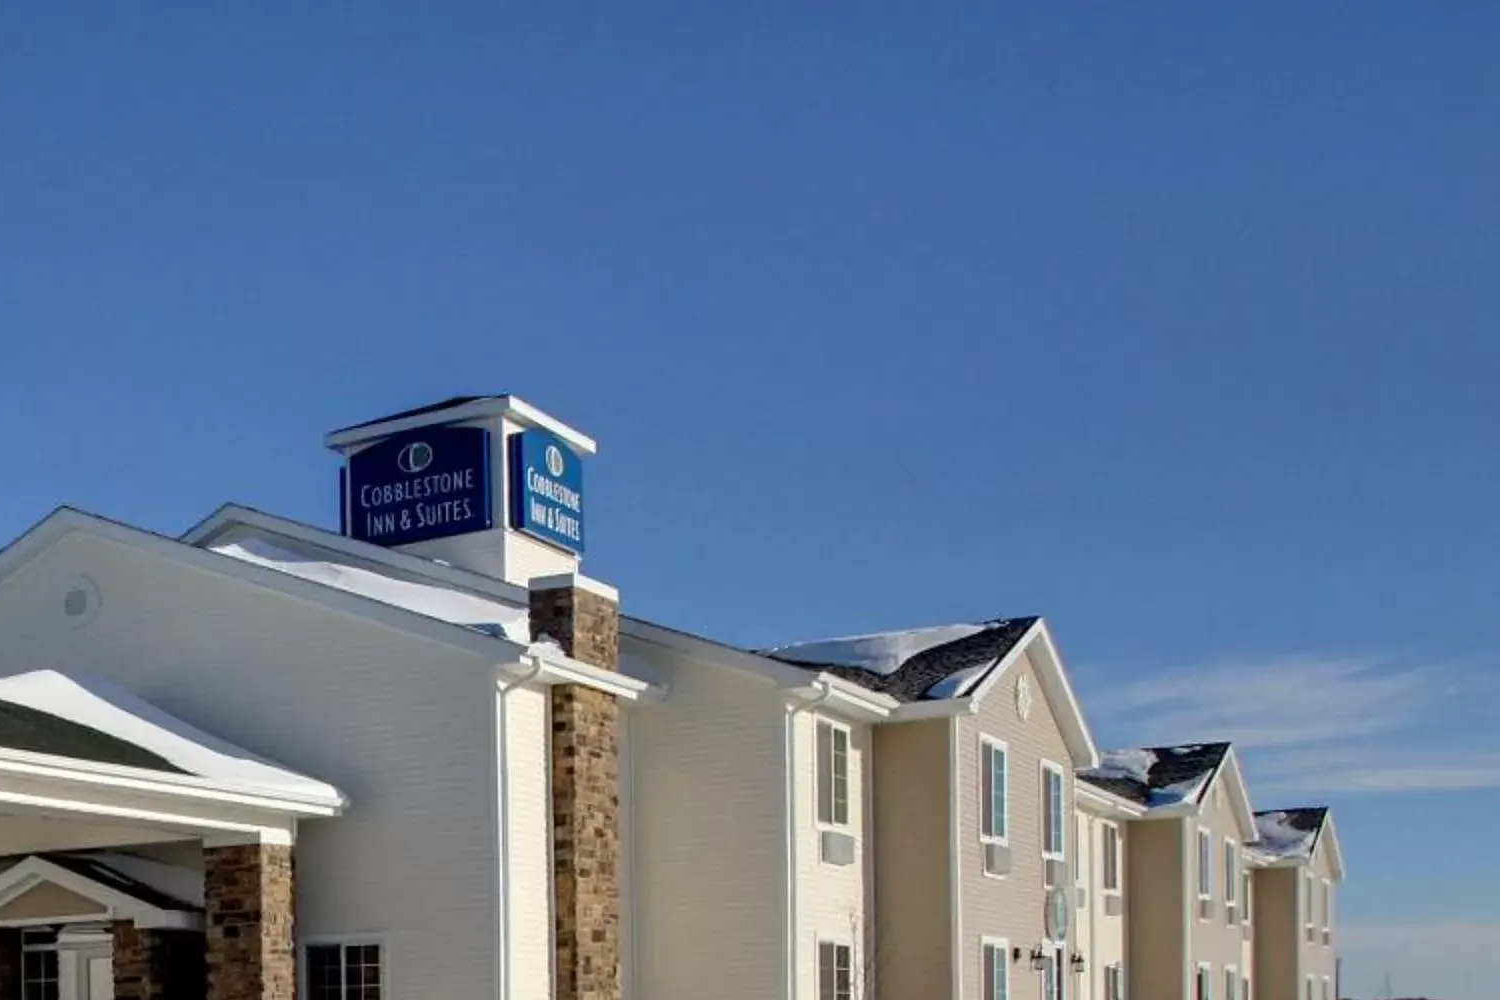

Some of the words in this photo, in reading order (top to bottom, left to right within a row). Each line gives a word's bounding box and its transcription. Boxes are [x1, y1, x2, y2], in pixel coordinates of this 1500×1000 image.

[361, 468, 474, 508] COBBLESTONE
[367, 511, 395, 538] INN
[399, 508, 412, 531] &
[416, 498, 472, 528] SUITES
